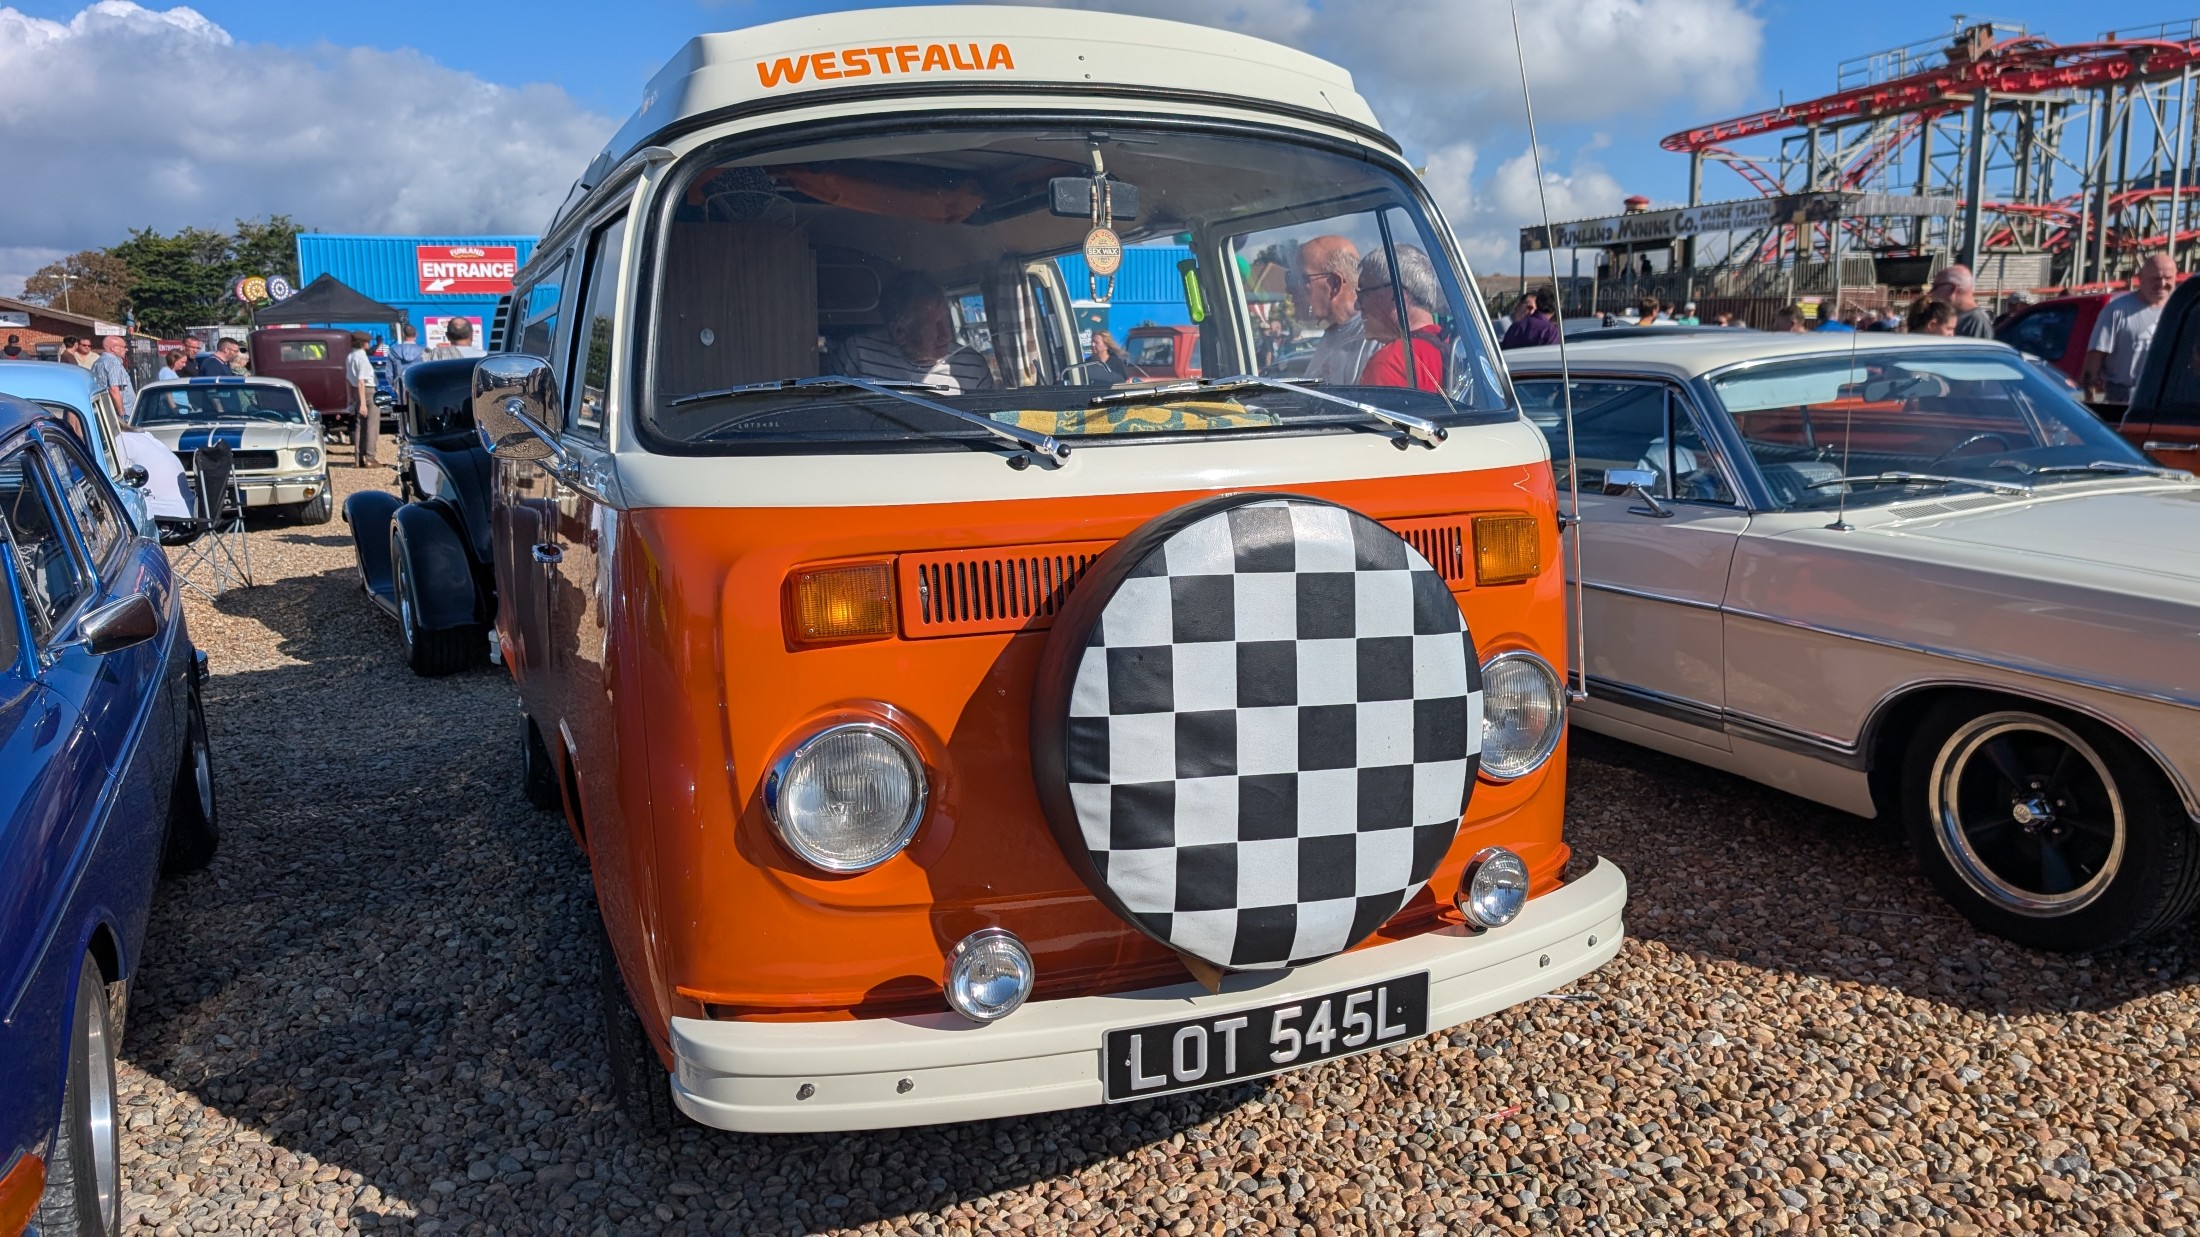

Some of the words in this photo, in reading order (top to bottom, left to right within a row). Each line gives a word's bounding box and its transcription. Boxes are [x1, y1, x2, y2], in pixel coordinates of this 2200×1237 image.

[756, 43, 1015, 88] WESTFALIA
[1618, 218, 1671, 239] MINING
[449, 247, 486, 257] FUNLAND
[422, 262, 515, 278] ENTRANCE
[1130, 1016, 1248, 1090] LOT
[1269, 986, 1407, 1064] 545L
